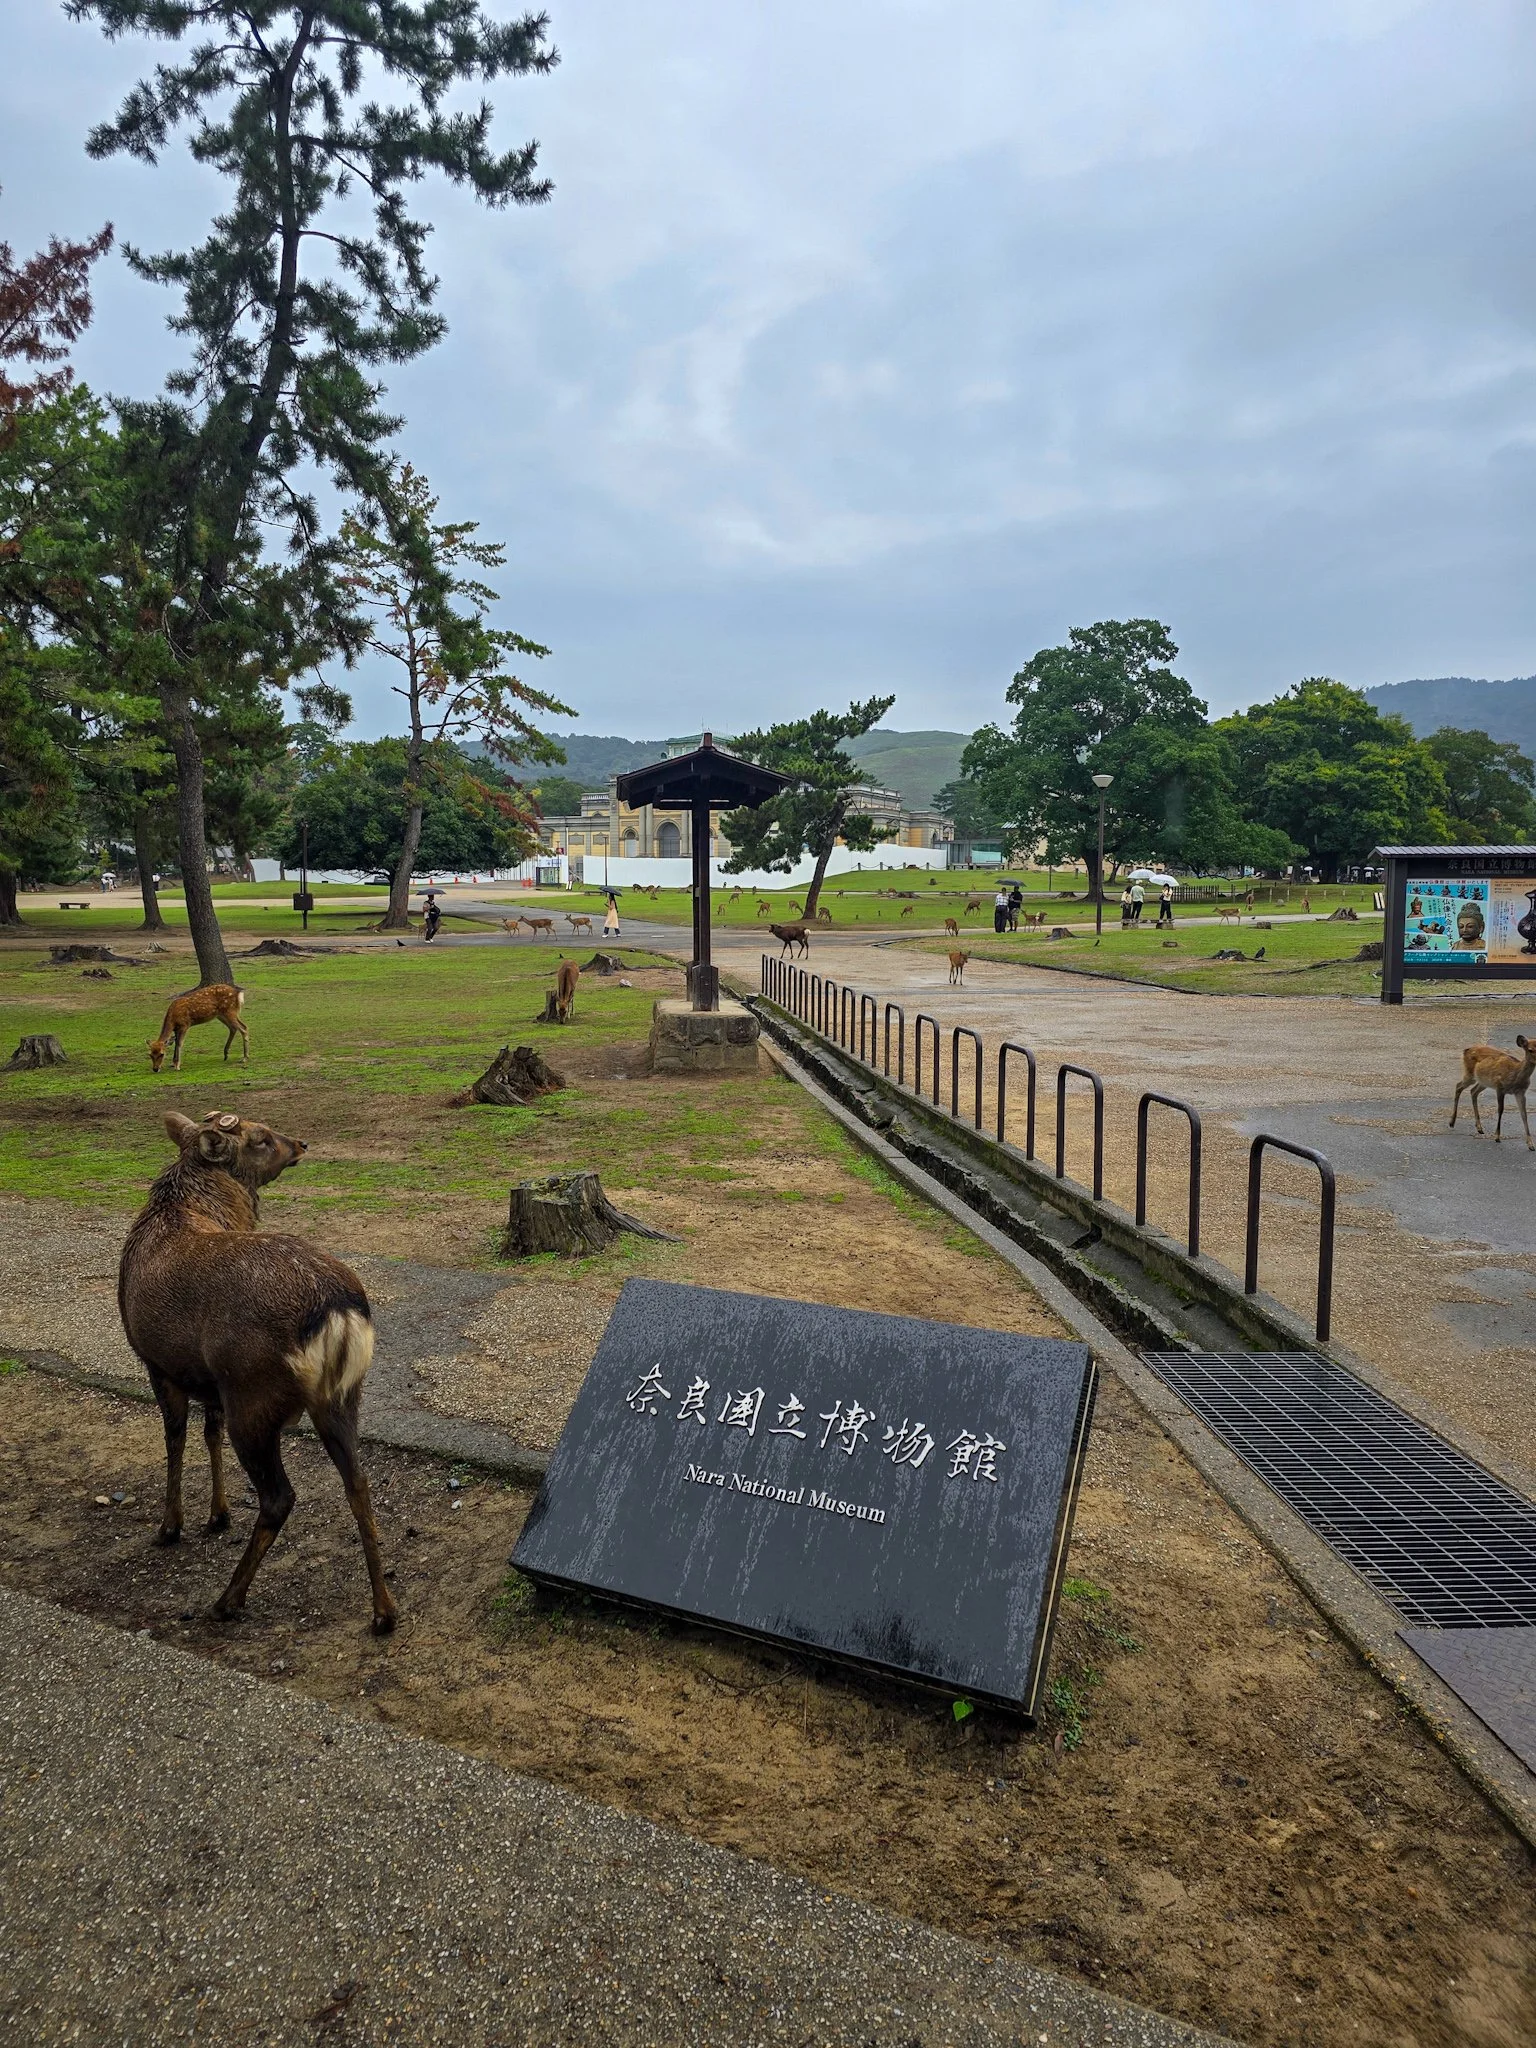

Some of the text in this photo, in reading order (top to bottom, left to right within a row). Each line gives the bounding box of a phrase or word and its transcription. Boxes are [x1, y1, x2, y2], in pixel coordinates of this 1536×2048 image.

[683, 1463, 887, 1525] Nara National Museum
